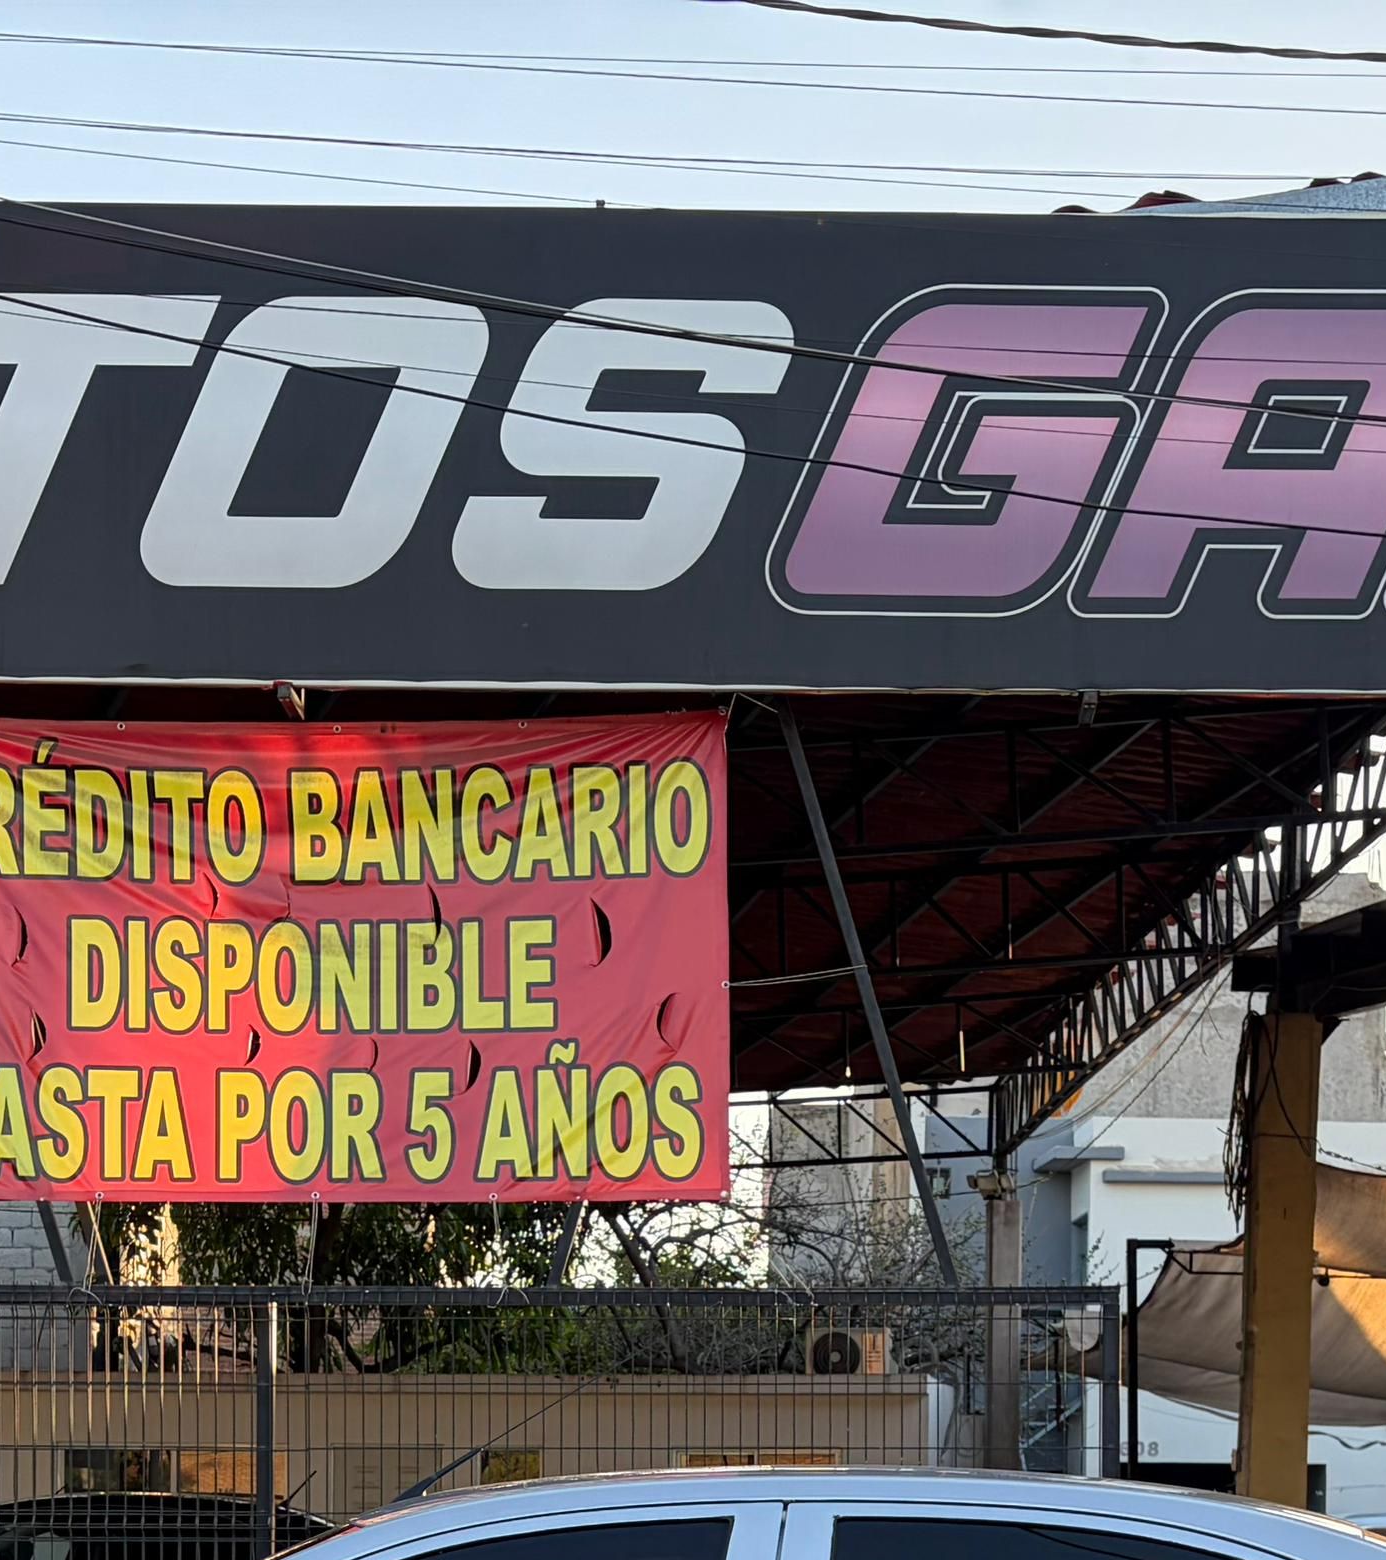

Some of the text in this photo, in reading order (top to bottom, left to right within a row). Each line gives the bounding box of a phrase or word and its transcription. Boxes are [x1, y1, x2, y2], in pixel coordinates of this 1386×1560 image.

[287, 756, 713, 886] BANCARIO
[66, 914, 559, 1035] DISPONIBLE
[214, 1066, 387, 1184] POR
[405, 1067, 456, 1184] 5
[475, 1038, 706, 1184] AÑOS
